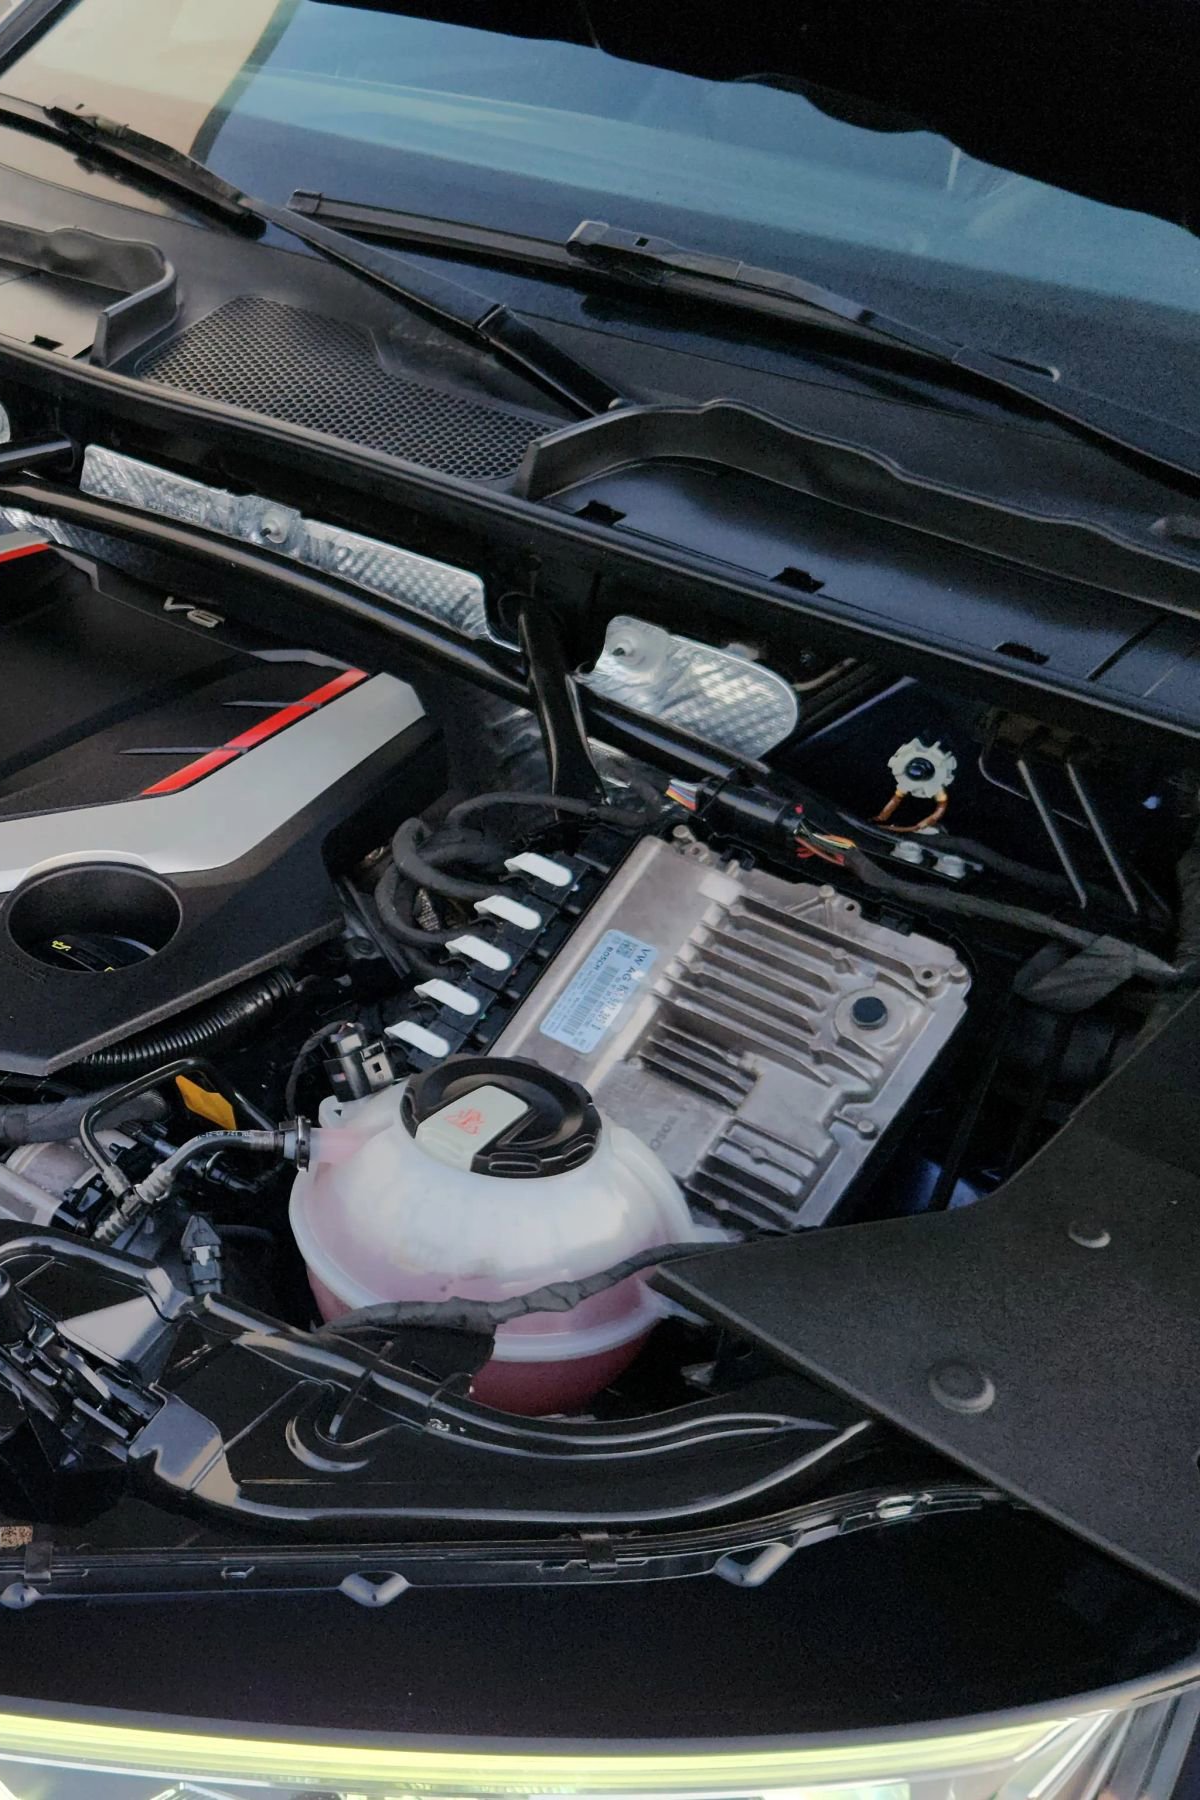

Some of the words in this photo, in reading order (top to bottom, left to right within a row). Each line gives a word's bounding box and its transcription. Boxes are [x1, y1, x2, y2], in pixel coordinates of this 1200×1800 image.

[163, 596, 225, 628] V6
[593, 946, 614, 971] BOSCH
[633, 947, 652, 966] VW
